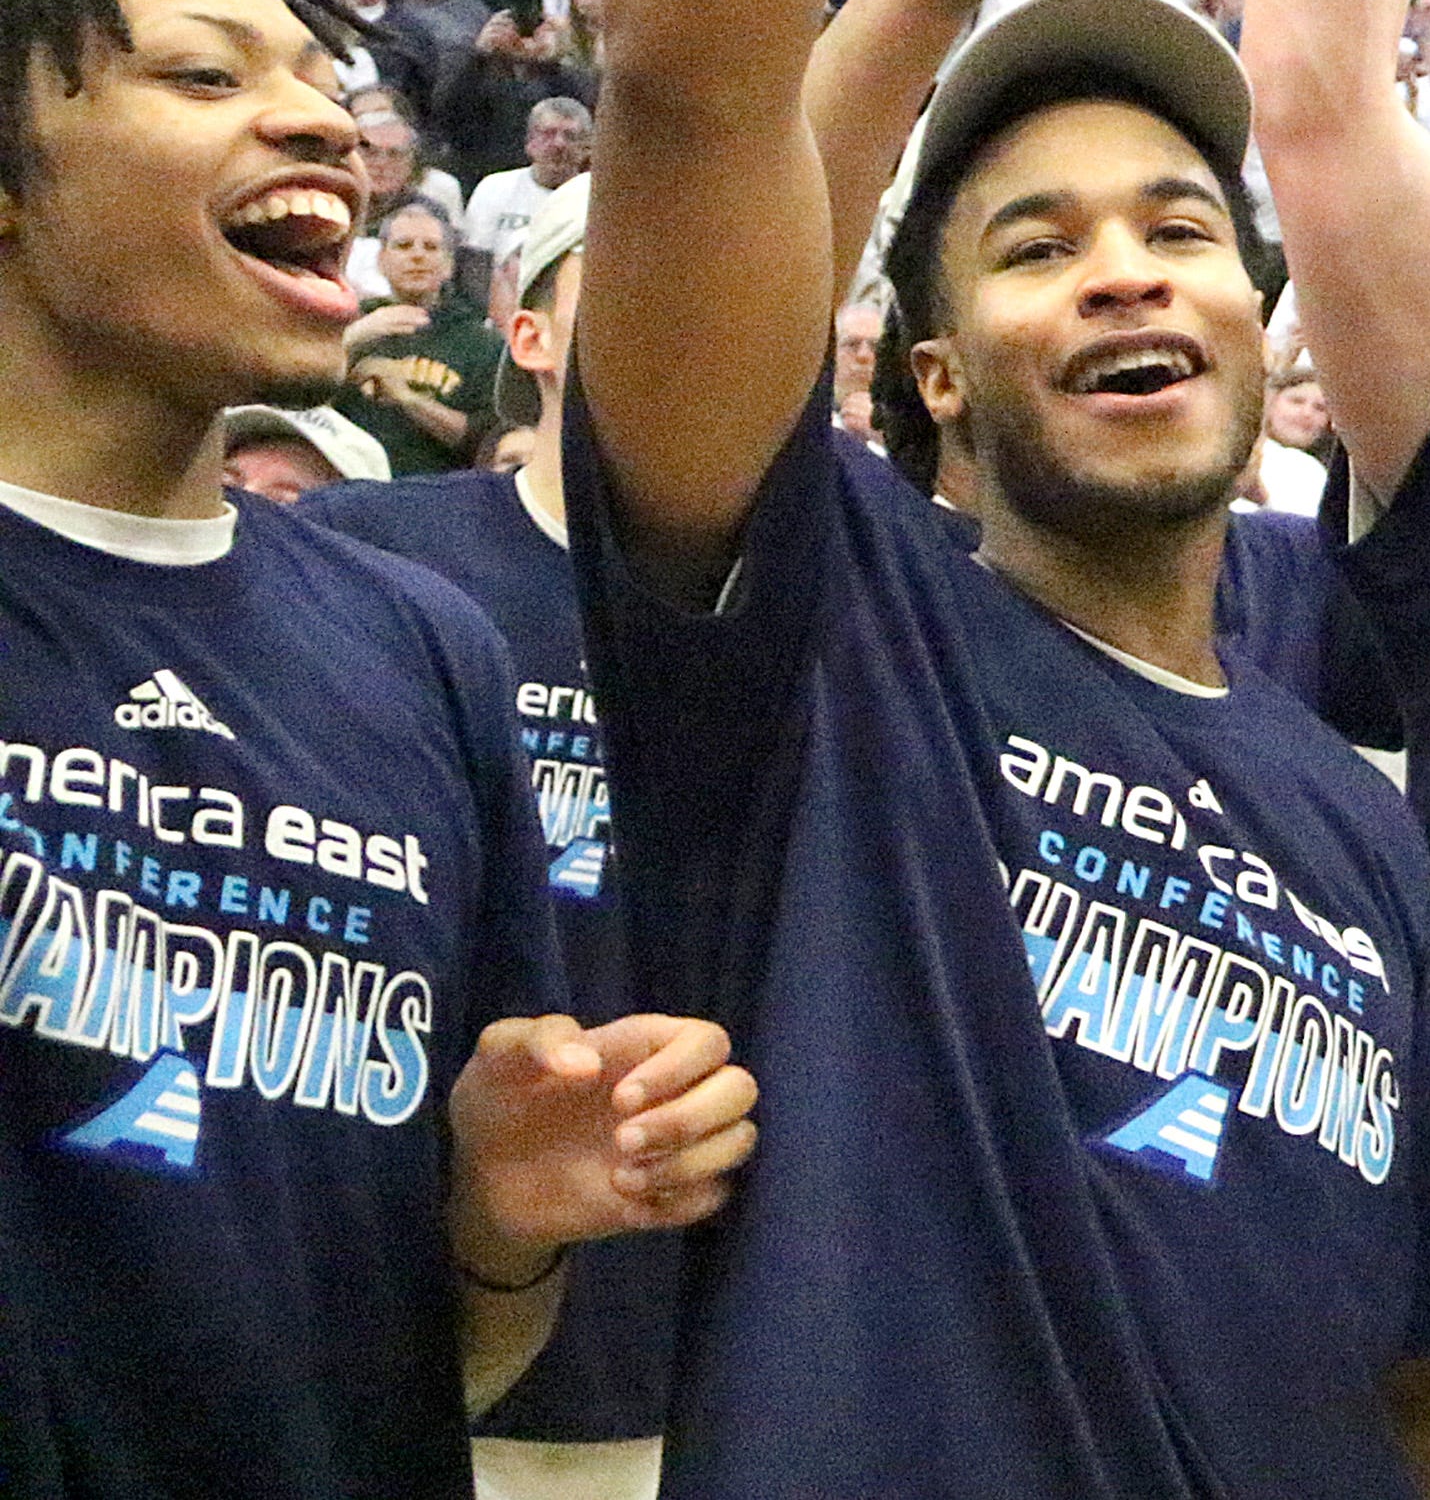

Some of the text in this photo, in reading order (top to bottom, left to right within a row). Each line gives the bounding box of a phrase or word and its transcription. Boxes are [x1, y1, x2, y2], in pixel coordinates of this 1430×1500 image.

[265, 805, 428, 905] east
[1040, 830, 1365, 1016] CONFERENCE
[998, 861, 1400, 1185] HAMPIONS
